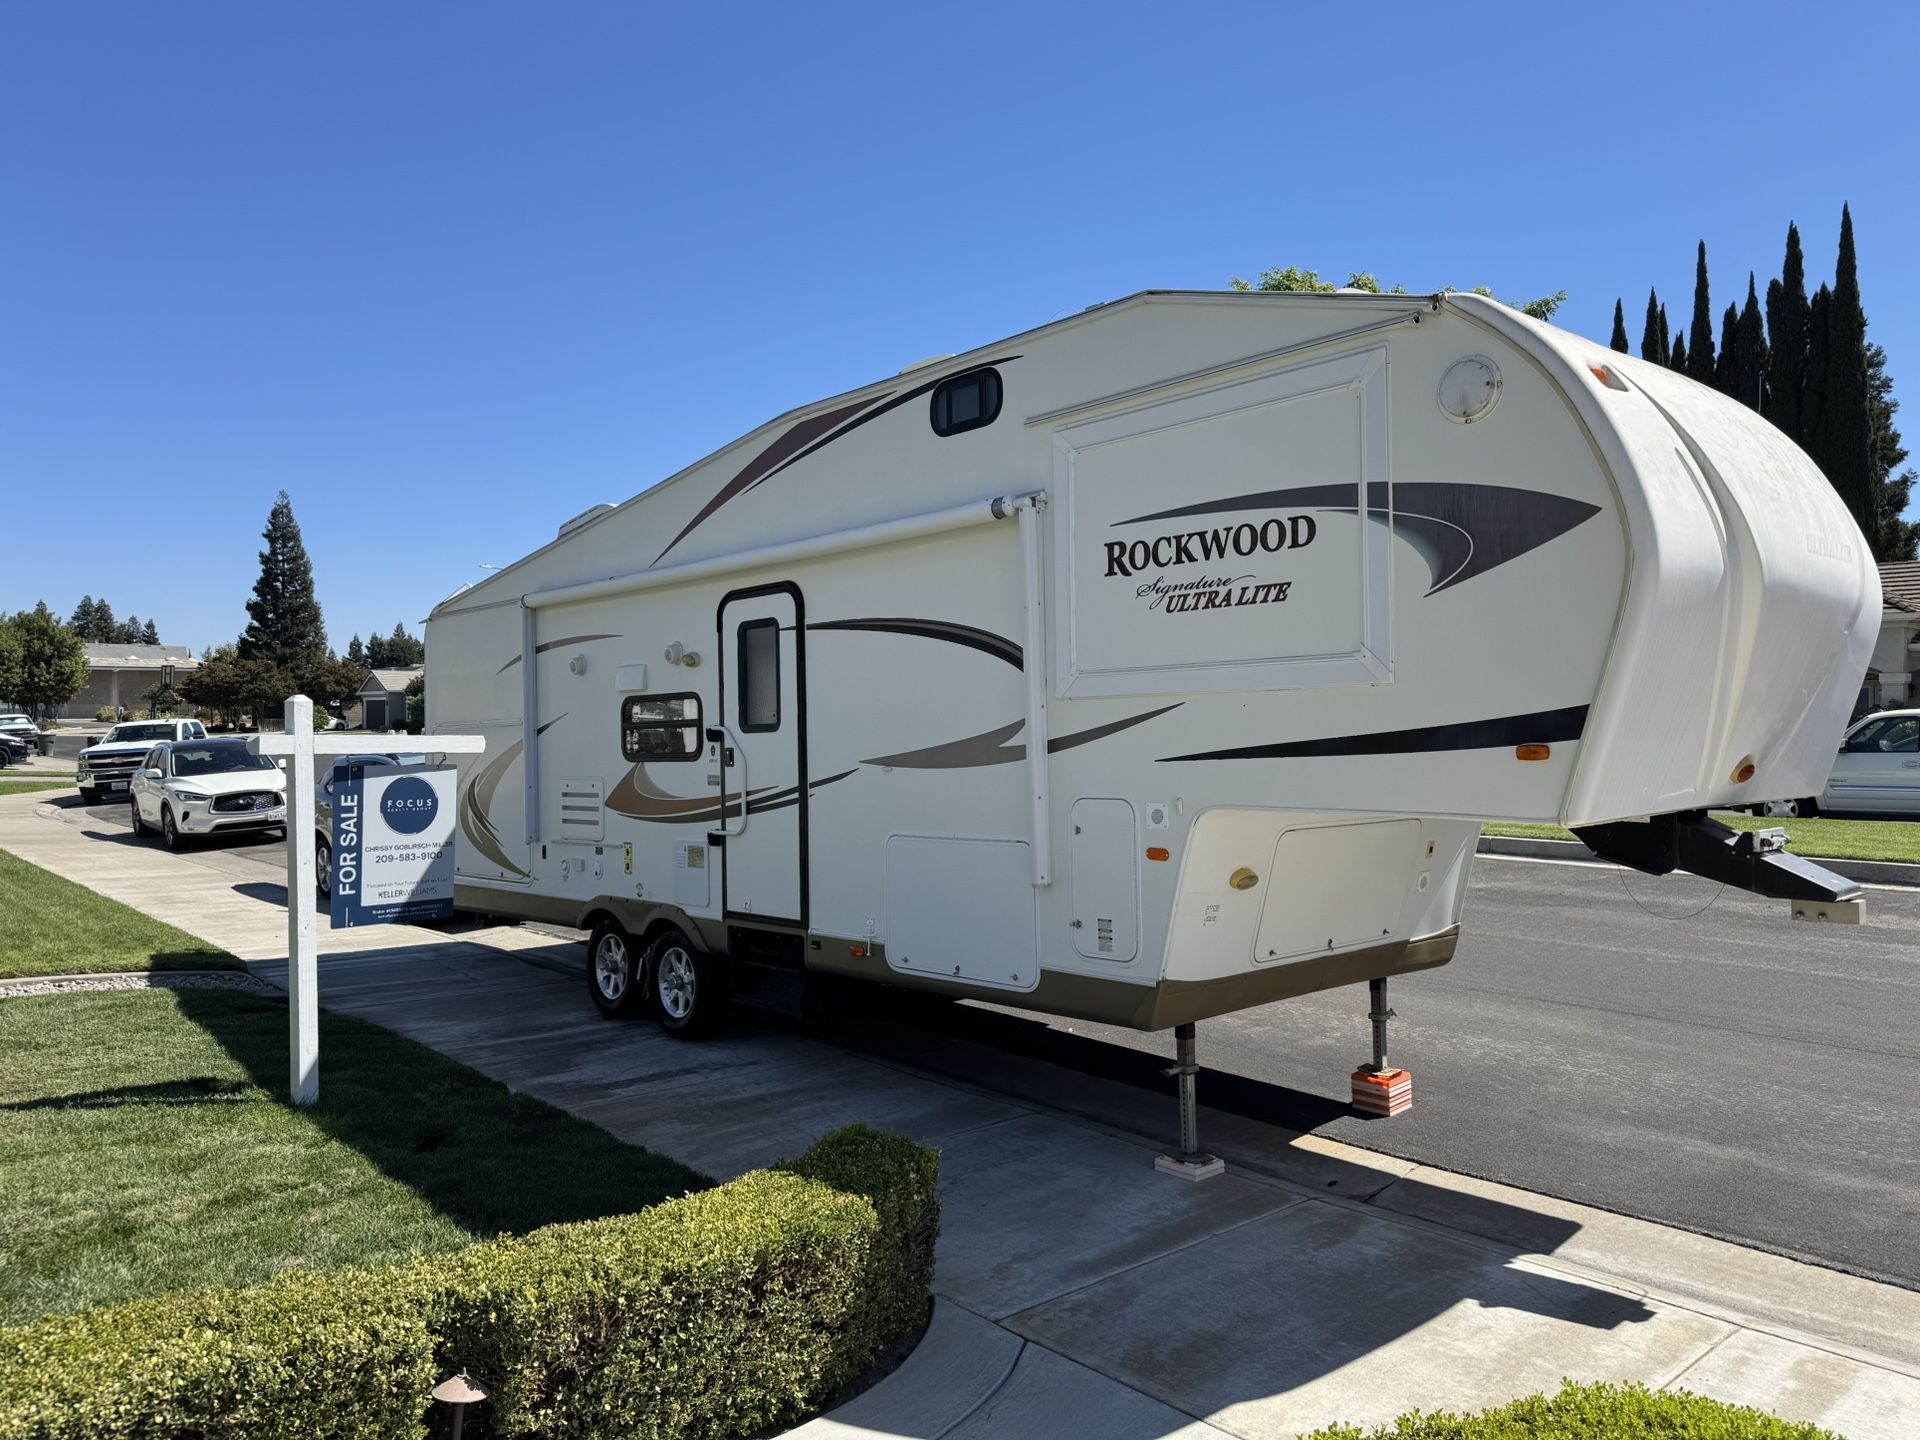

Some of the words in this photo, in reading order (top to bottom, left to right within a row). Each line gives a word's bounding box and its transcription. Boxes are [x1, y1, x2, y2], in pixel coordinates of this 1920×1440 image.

[1104, 515, 1317, 577] ROCKWOOD
[1136, 575, 1256, 610] Signature
[340, 794, 358, 846] SALE
[387, 799, 432, 808] FOCUS
[364, 845, 393, 853] CHRISSY
[375, 851, 443, 863] 209-583-9100
[339, 852, 357, 895] FOR
